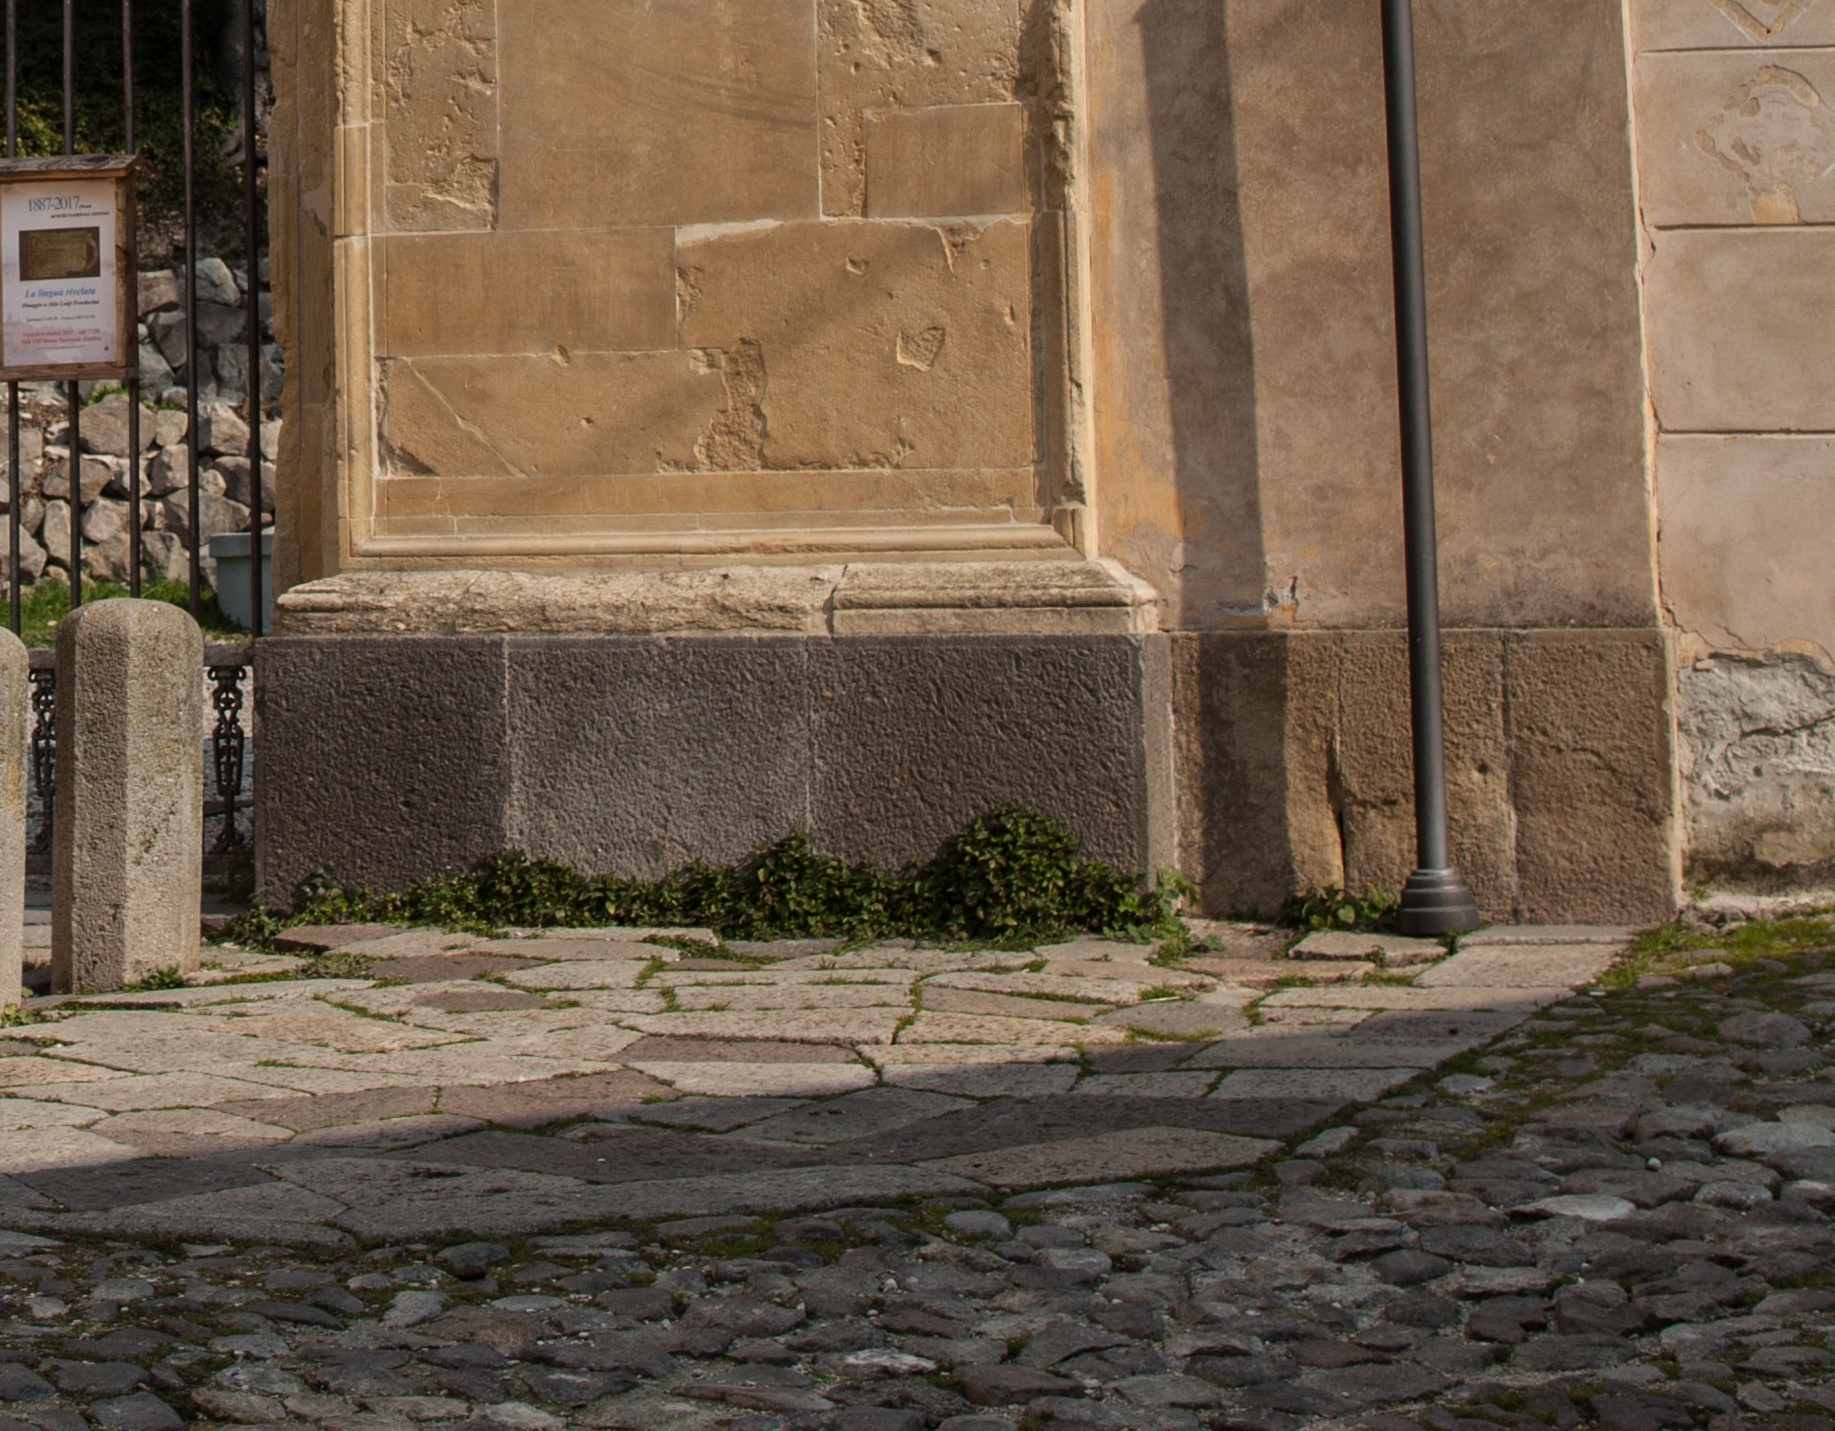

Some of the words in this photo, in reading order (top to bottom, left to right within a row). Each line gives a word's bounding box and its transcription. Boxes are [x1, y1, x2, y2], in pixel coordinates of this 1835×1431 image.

[28, 195, 81, 212] 1887-2017
[24, 289, 36, 298] La
[38, 289, 64, 299] lingua
